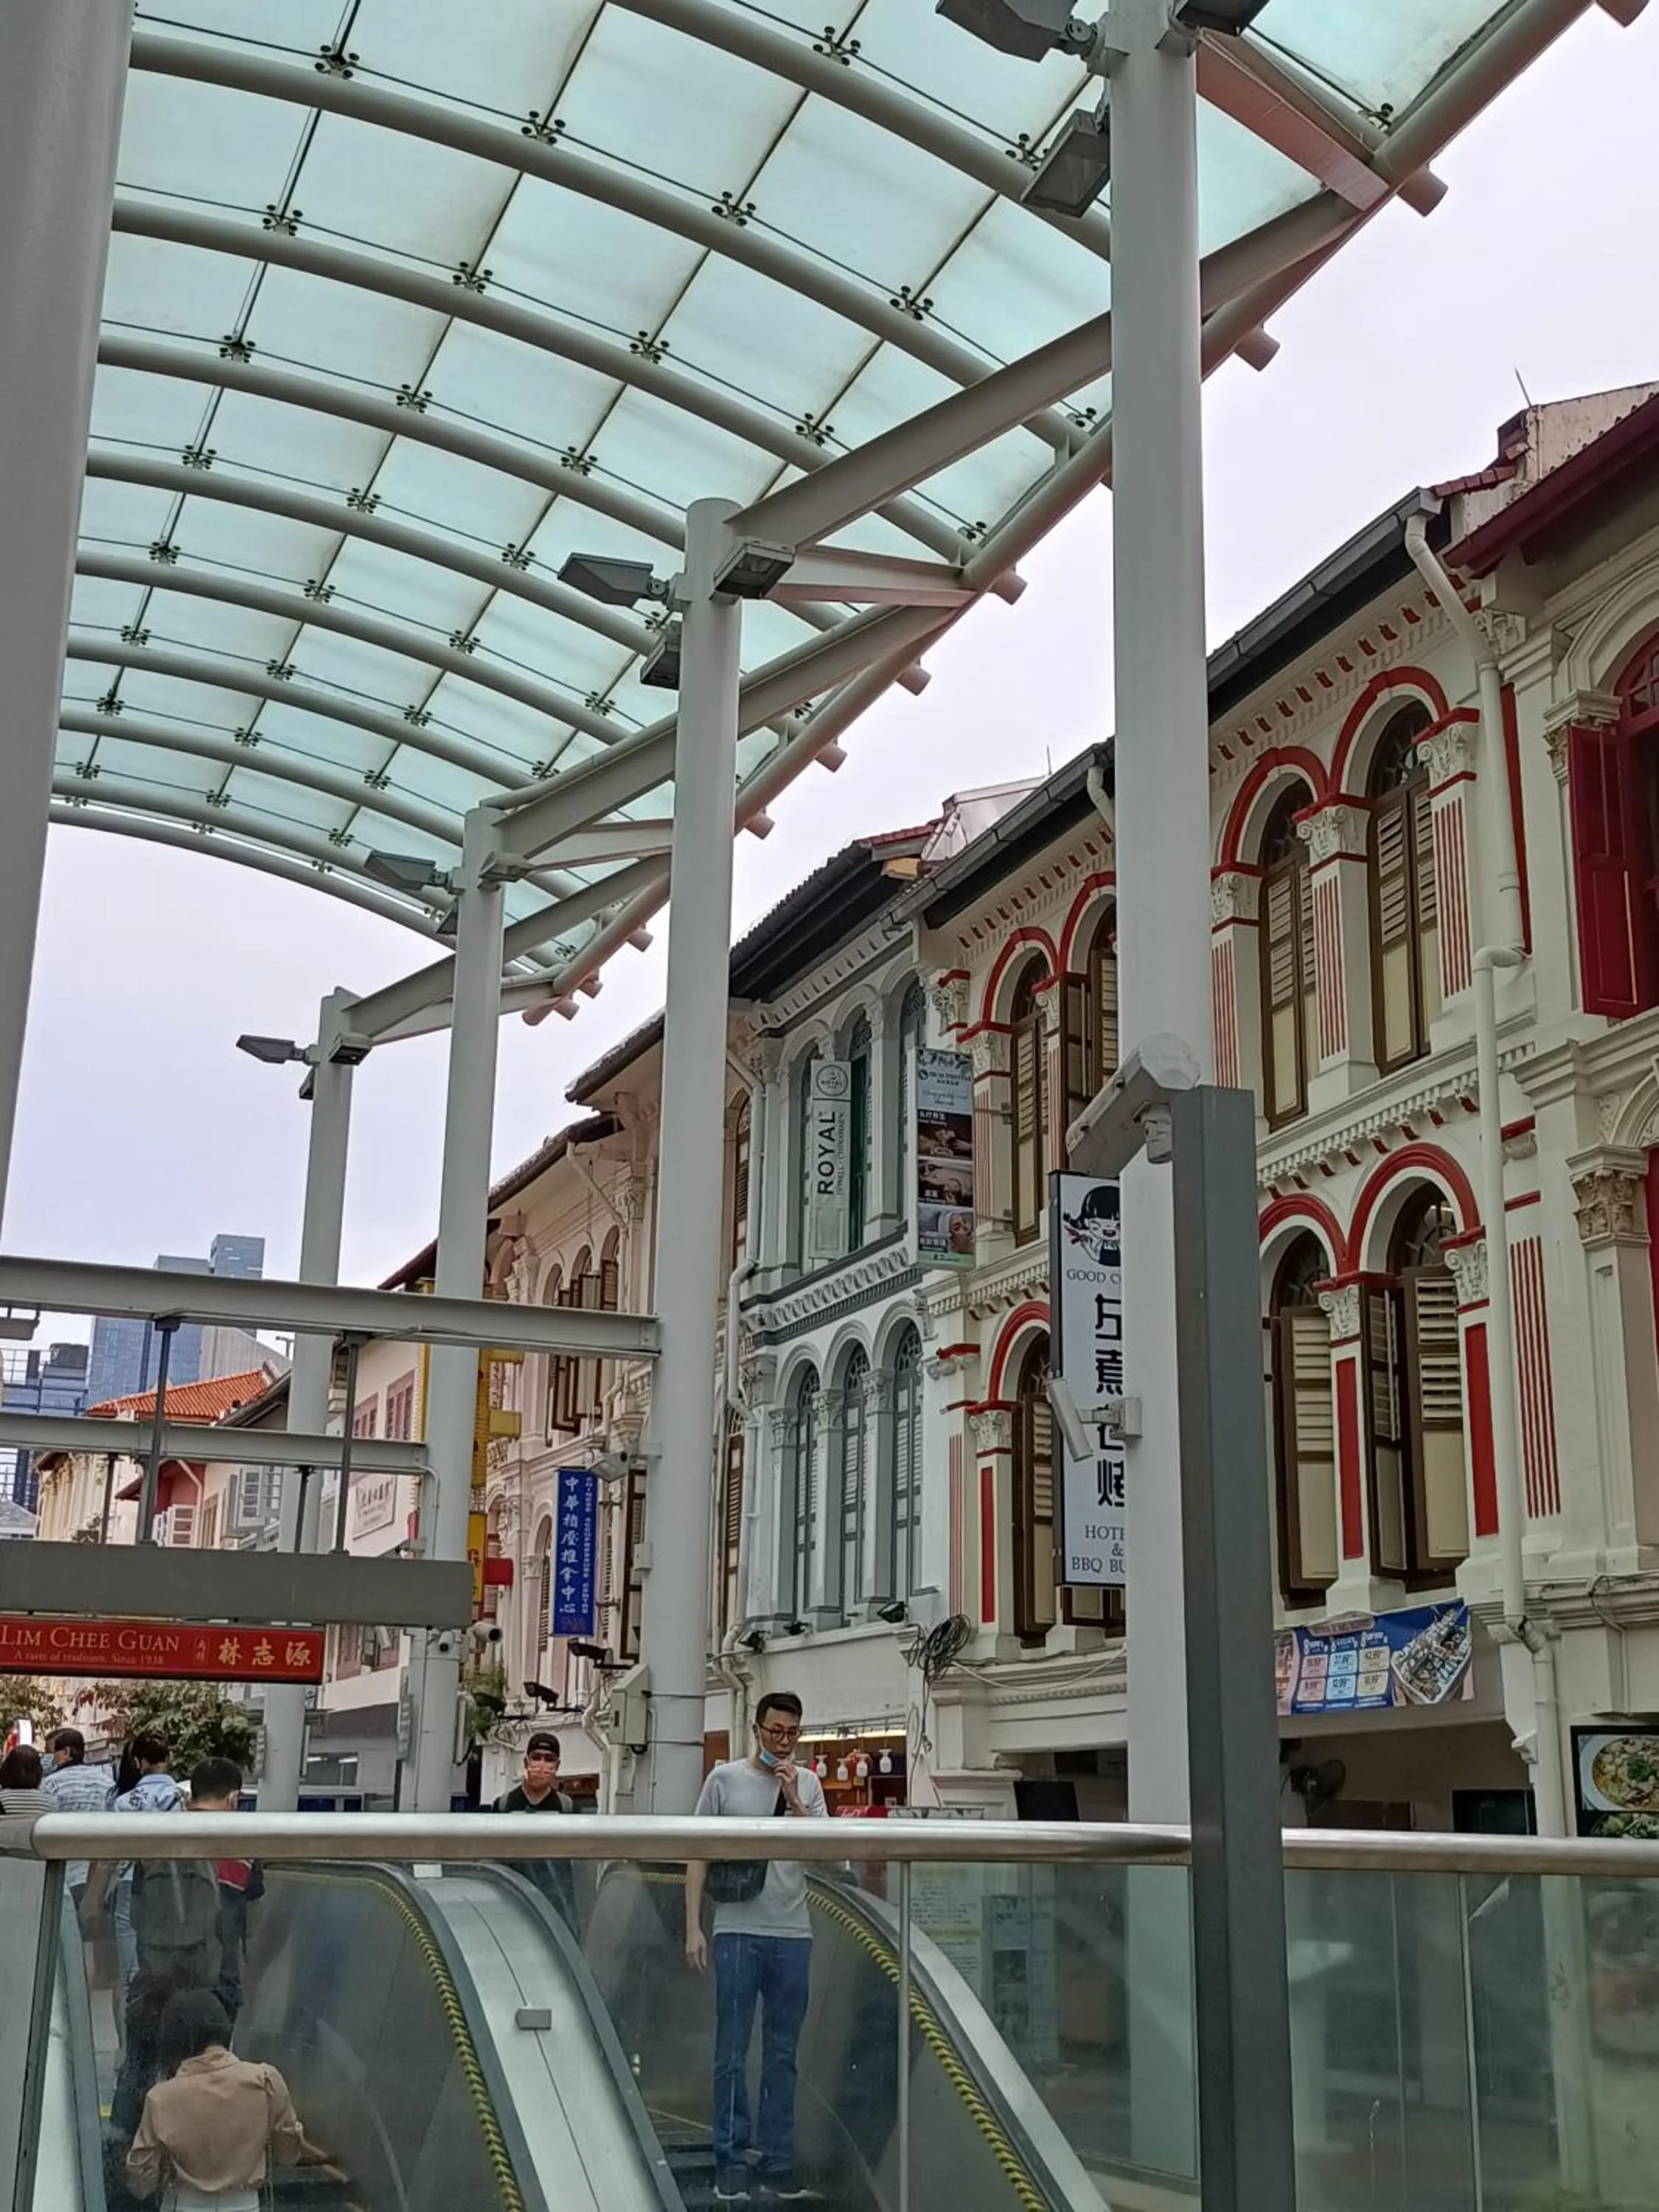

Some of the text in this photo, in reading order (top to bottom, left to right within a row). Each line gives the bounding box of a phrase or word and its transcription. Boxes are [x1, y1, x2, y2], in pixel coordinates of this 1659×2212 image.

[818, 1111, 835, 1195] ROYAL
[1066, 1268, 1121, 1285] GOOD C
[1072, 1557, 1102, 1573] BBQ
[1, 1624, 44, 1646] LIM
[50, 1626, 111, 1649] CHEE
[118, 1629, 181, 1652] GUAN
[111, 1654, 136, 1664] Since
[218, 1637, 311, 1666] 林志源
